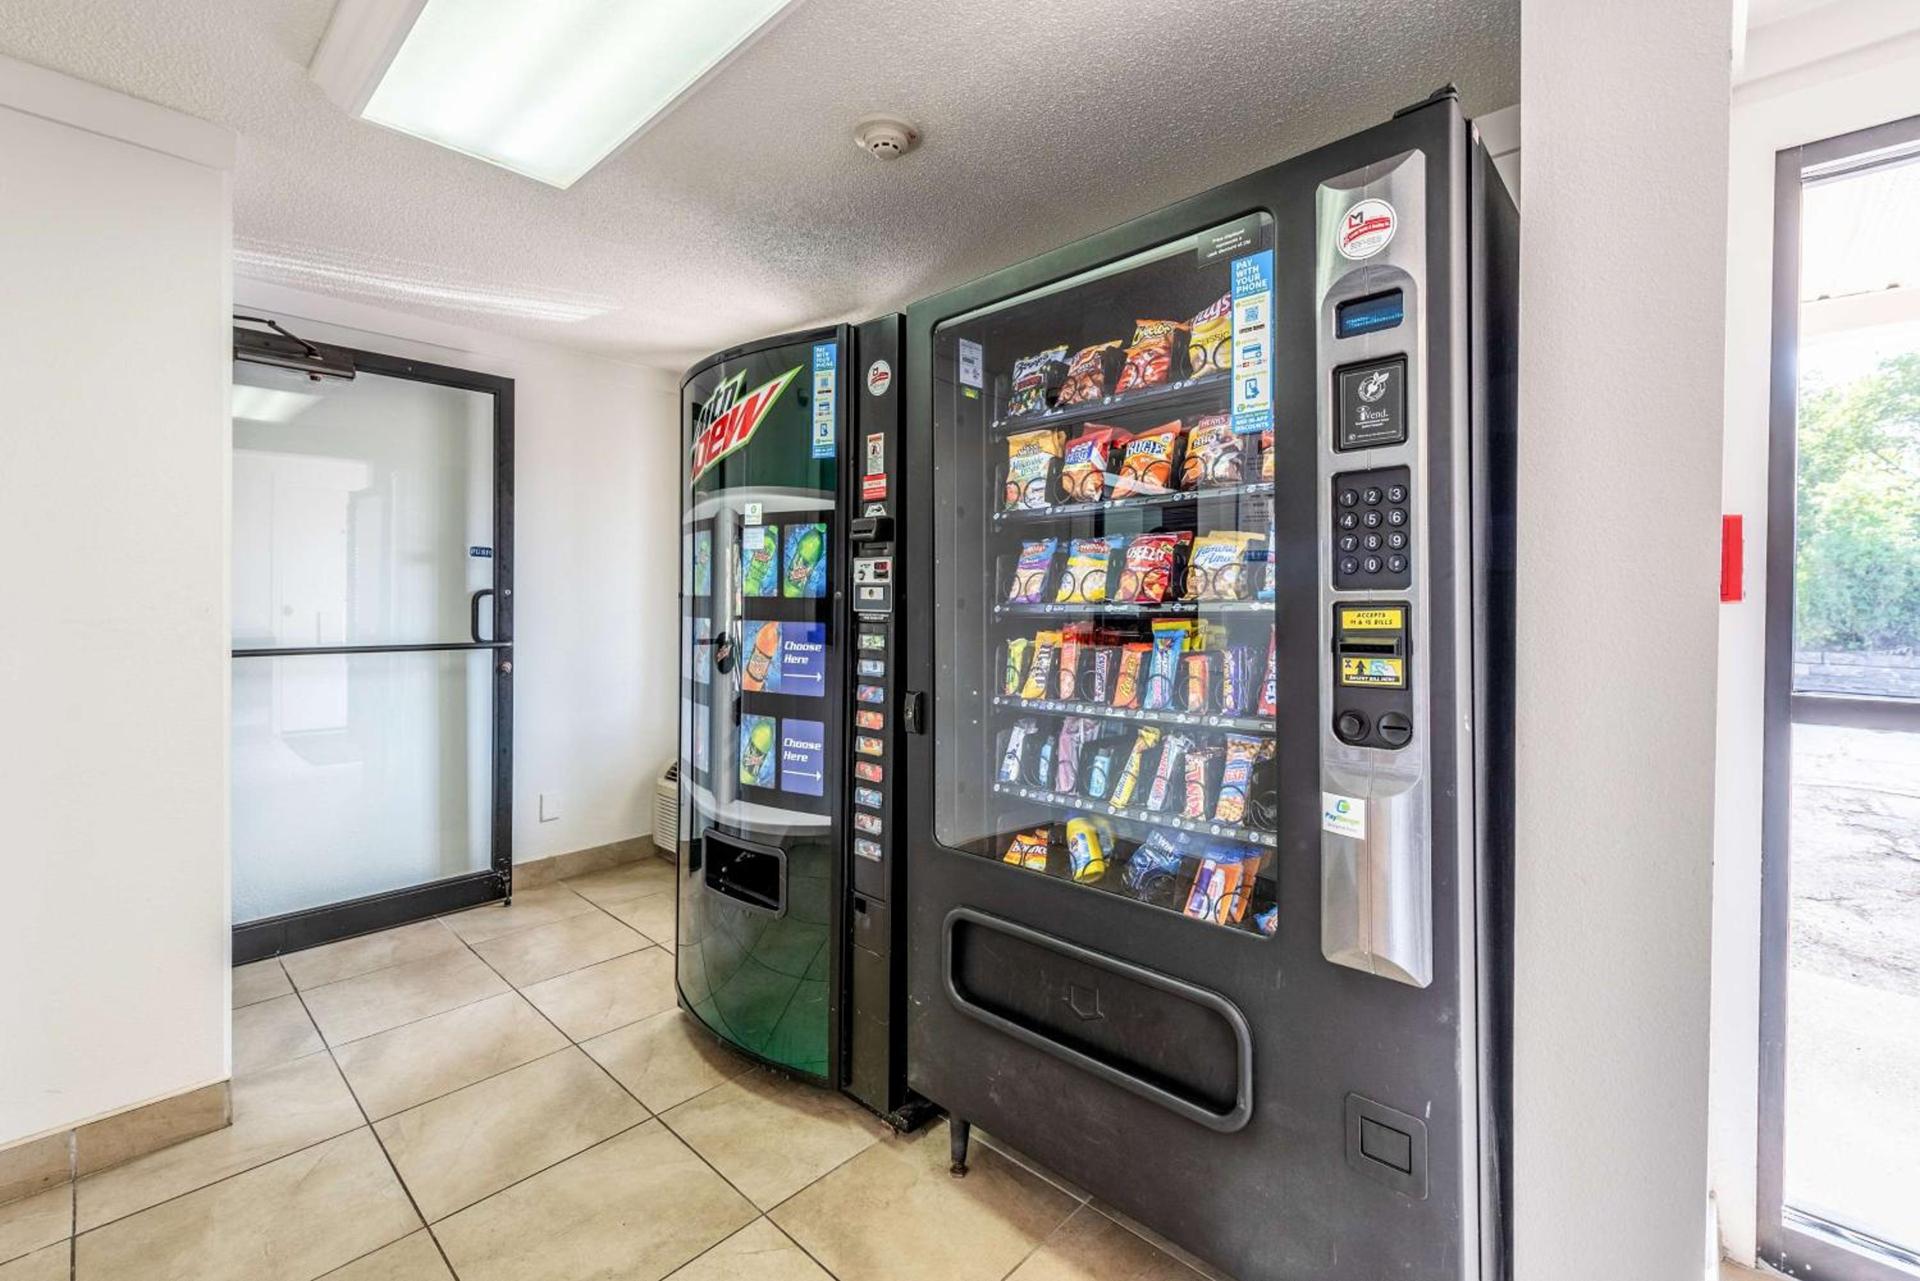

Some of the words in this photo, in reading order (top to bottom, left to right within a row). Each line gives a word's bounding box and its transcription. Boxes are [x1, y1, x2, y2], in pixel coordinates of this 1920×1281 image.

[1236, 257, 1253, 268] PAY
[1236, 264, 1260, 278] WITH
[1236, 272, 1261, 286] YOUR
[1236, 279, 1268, 294] PHONE
[1368, 491, 1376, 502] 2
[1393, 488, 1401, 500] 3
[1344, 515, 1352, 527] 4
[1368, 514, 1376, 525] 5
[1392, 511, 1401, 523] 6
[1345, 538, 1353, 549] 7
[1368, 536, 1376, 548] 8
[1393, 534, 1401, 547] 9
[1368, 558, 1376, 571] 0
[784, 640, 822, 652] Choose
[783, 654, 809, 664] Here
[784, 737, 822, 751] Choose
[783, 750, 809, 762] Here
